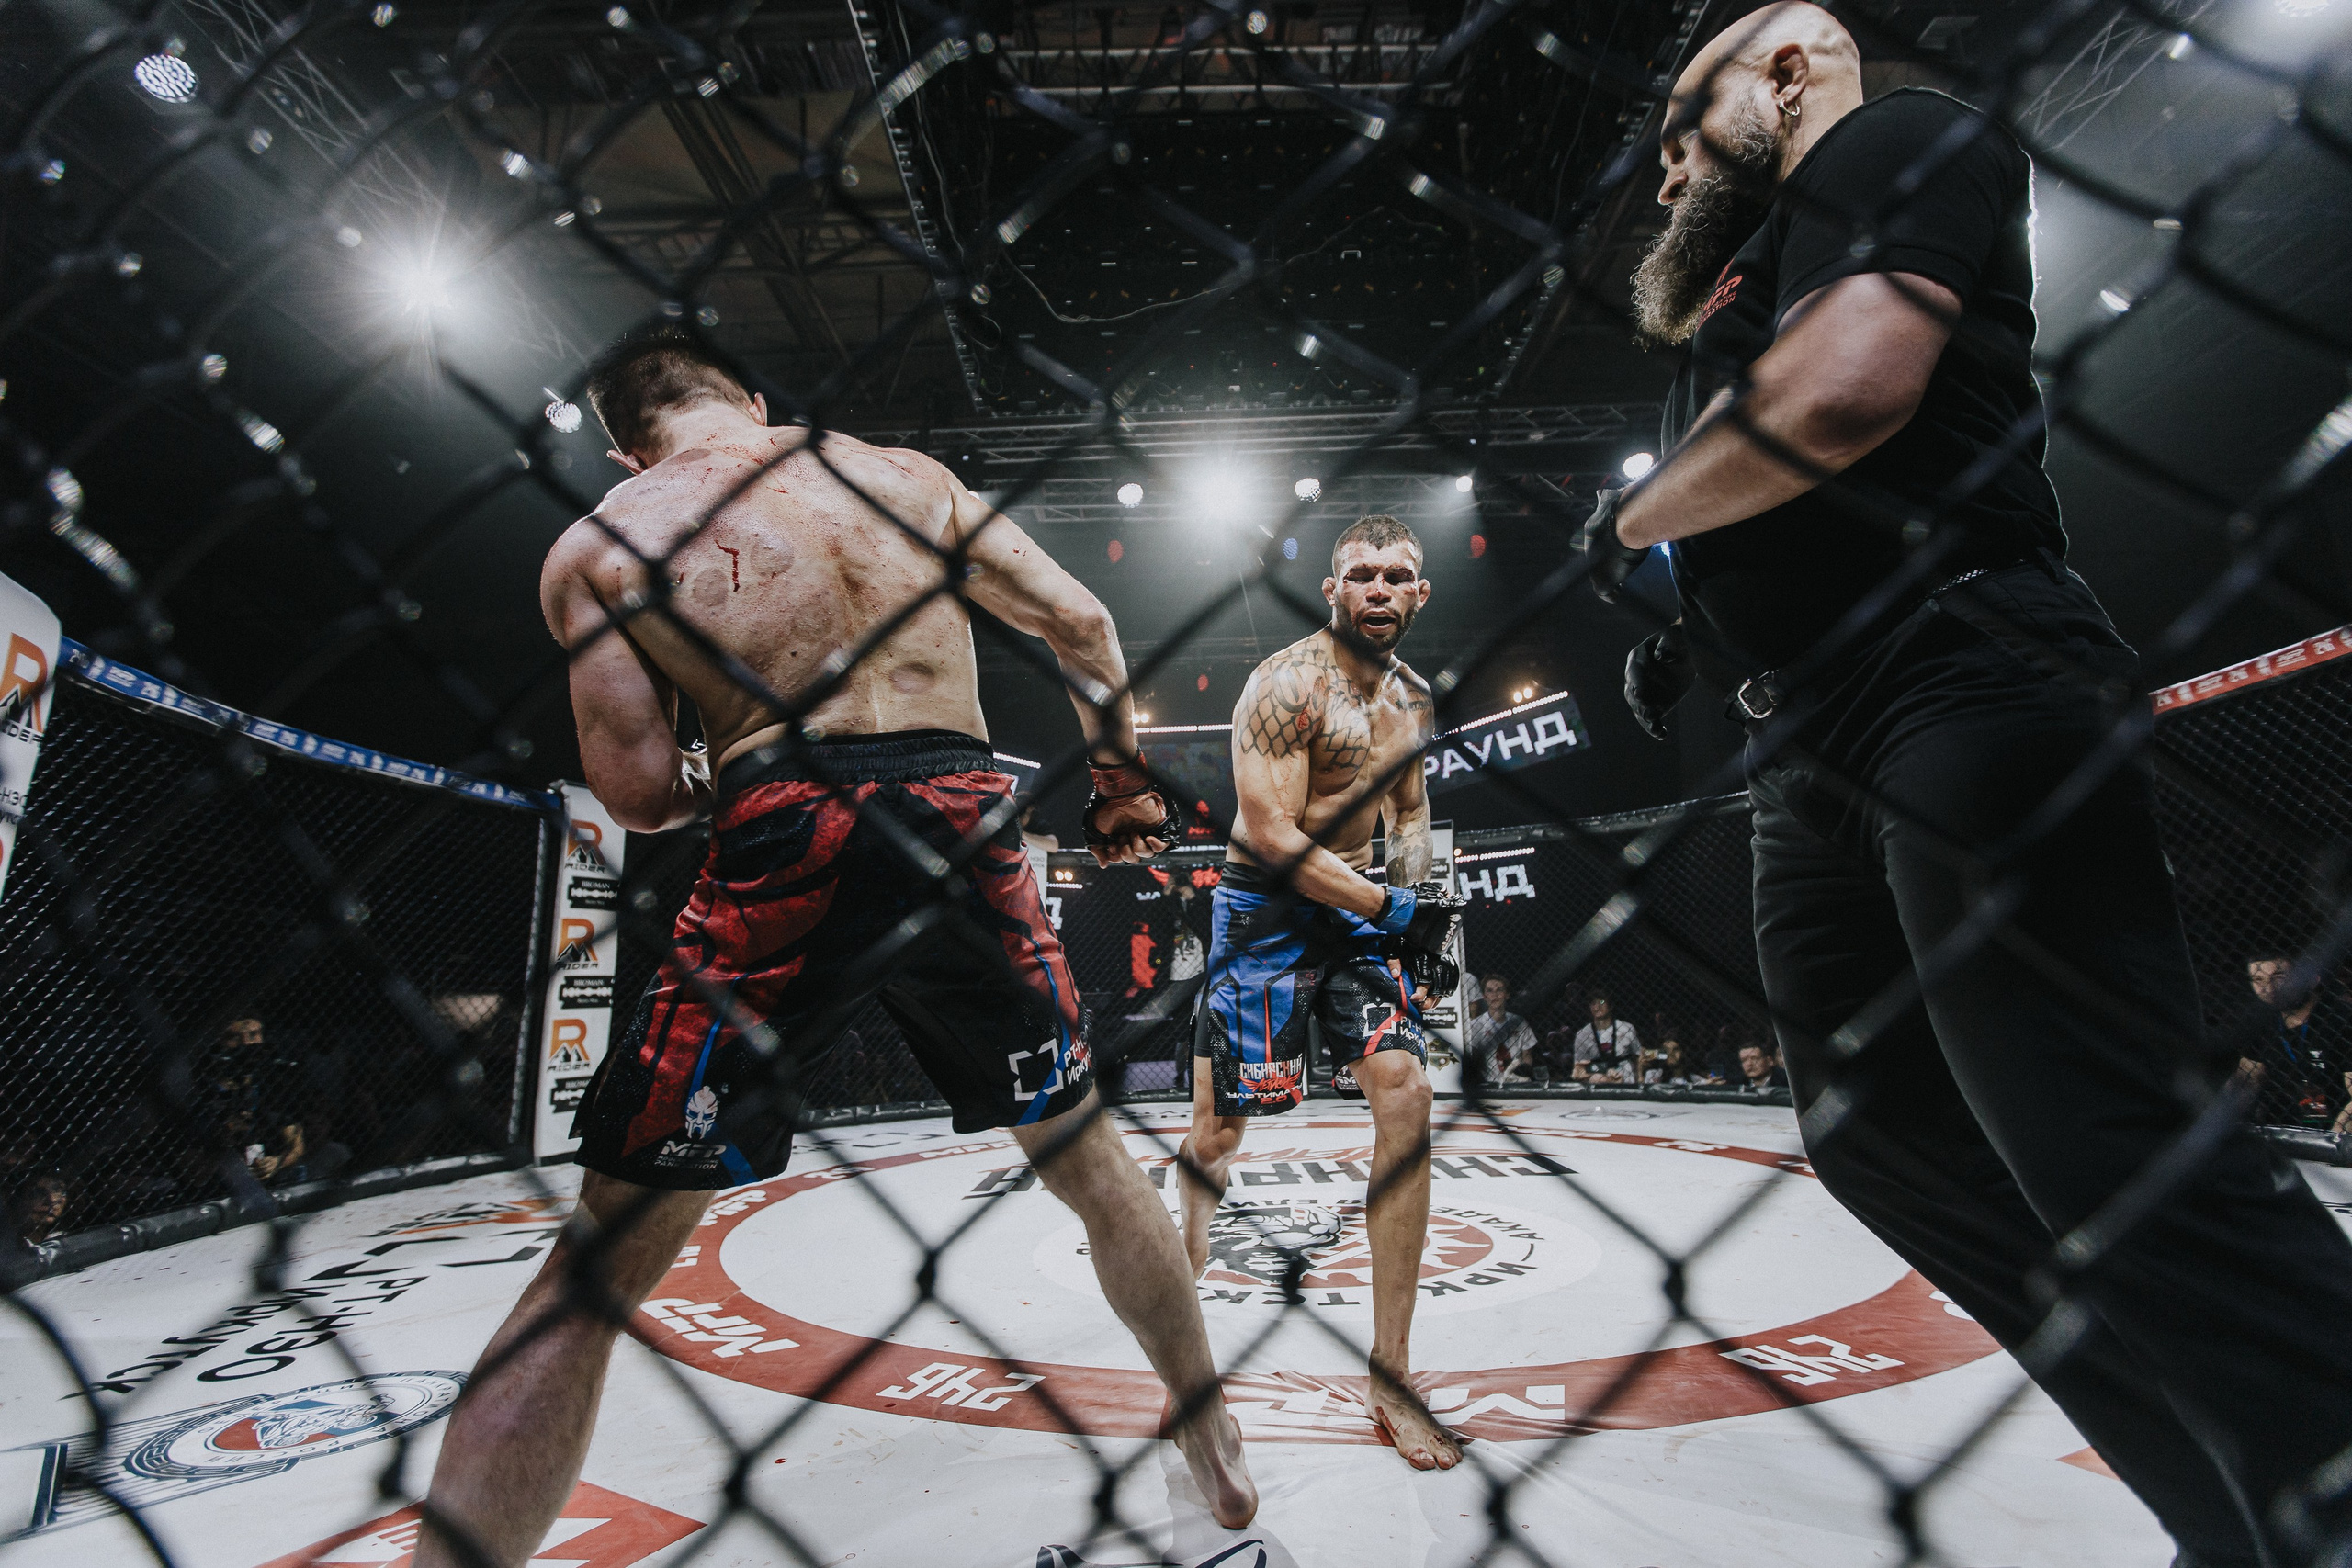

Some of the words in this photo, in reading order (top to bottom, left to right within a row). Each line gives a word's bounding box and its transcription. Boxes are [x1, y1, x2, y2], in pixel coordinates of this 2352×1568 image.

[1424, 711, 1577, 782] РАУНД
[581, 880, 610, 889] BROMAN
[556, 963, 599, 971] IDER
[1260, 1095, 1287, 1105] 2.0
[662, 1139, 727, 1157] MFP
[197, 1274, 432, 1382] РТ-НЭО
[640, 1297, 802, 1359] MFP
[1718, 1334, 1906, 1387] 246
[875, 1361, 1047, 1412] 246
